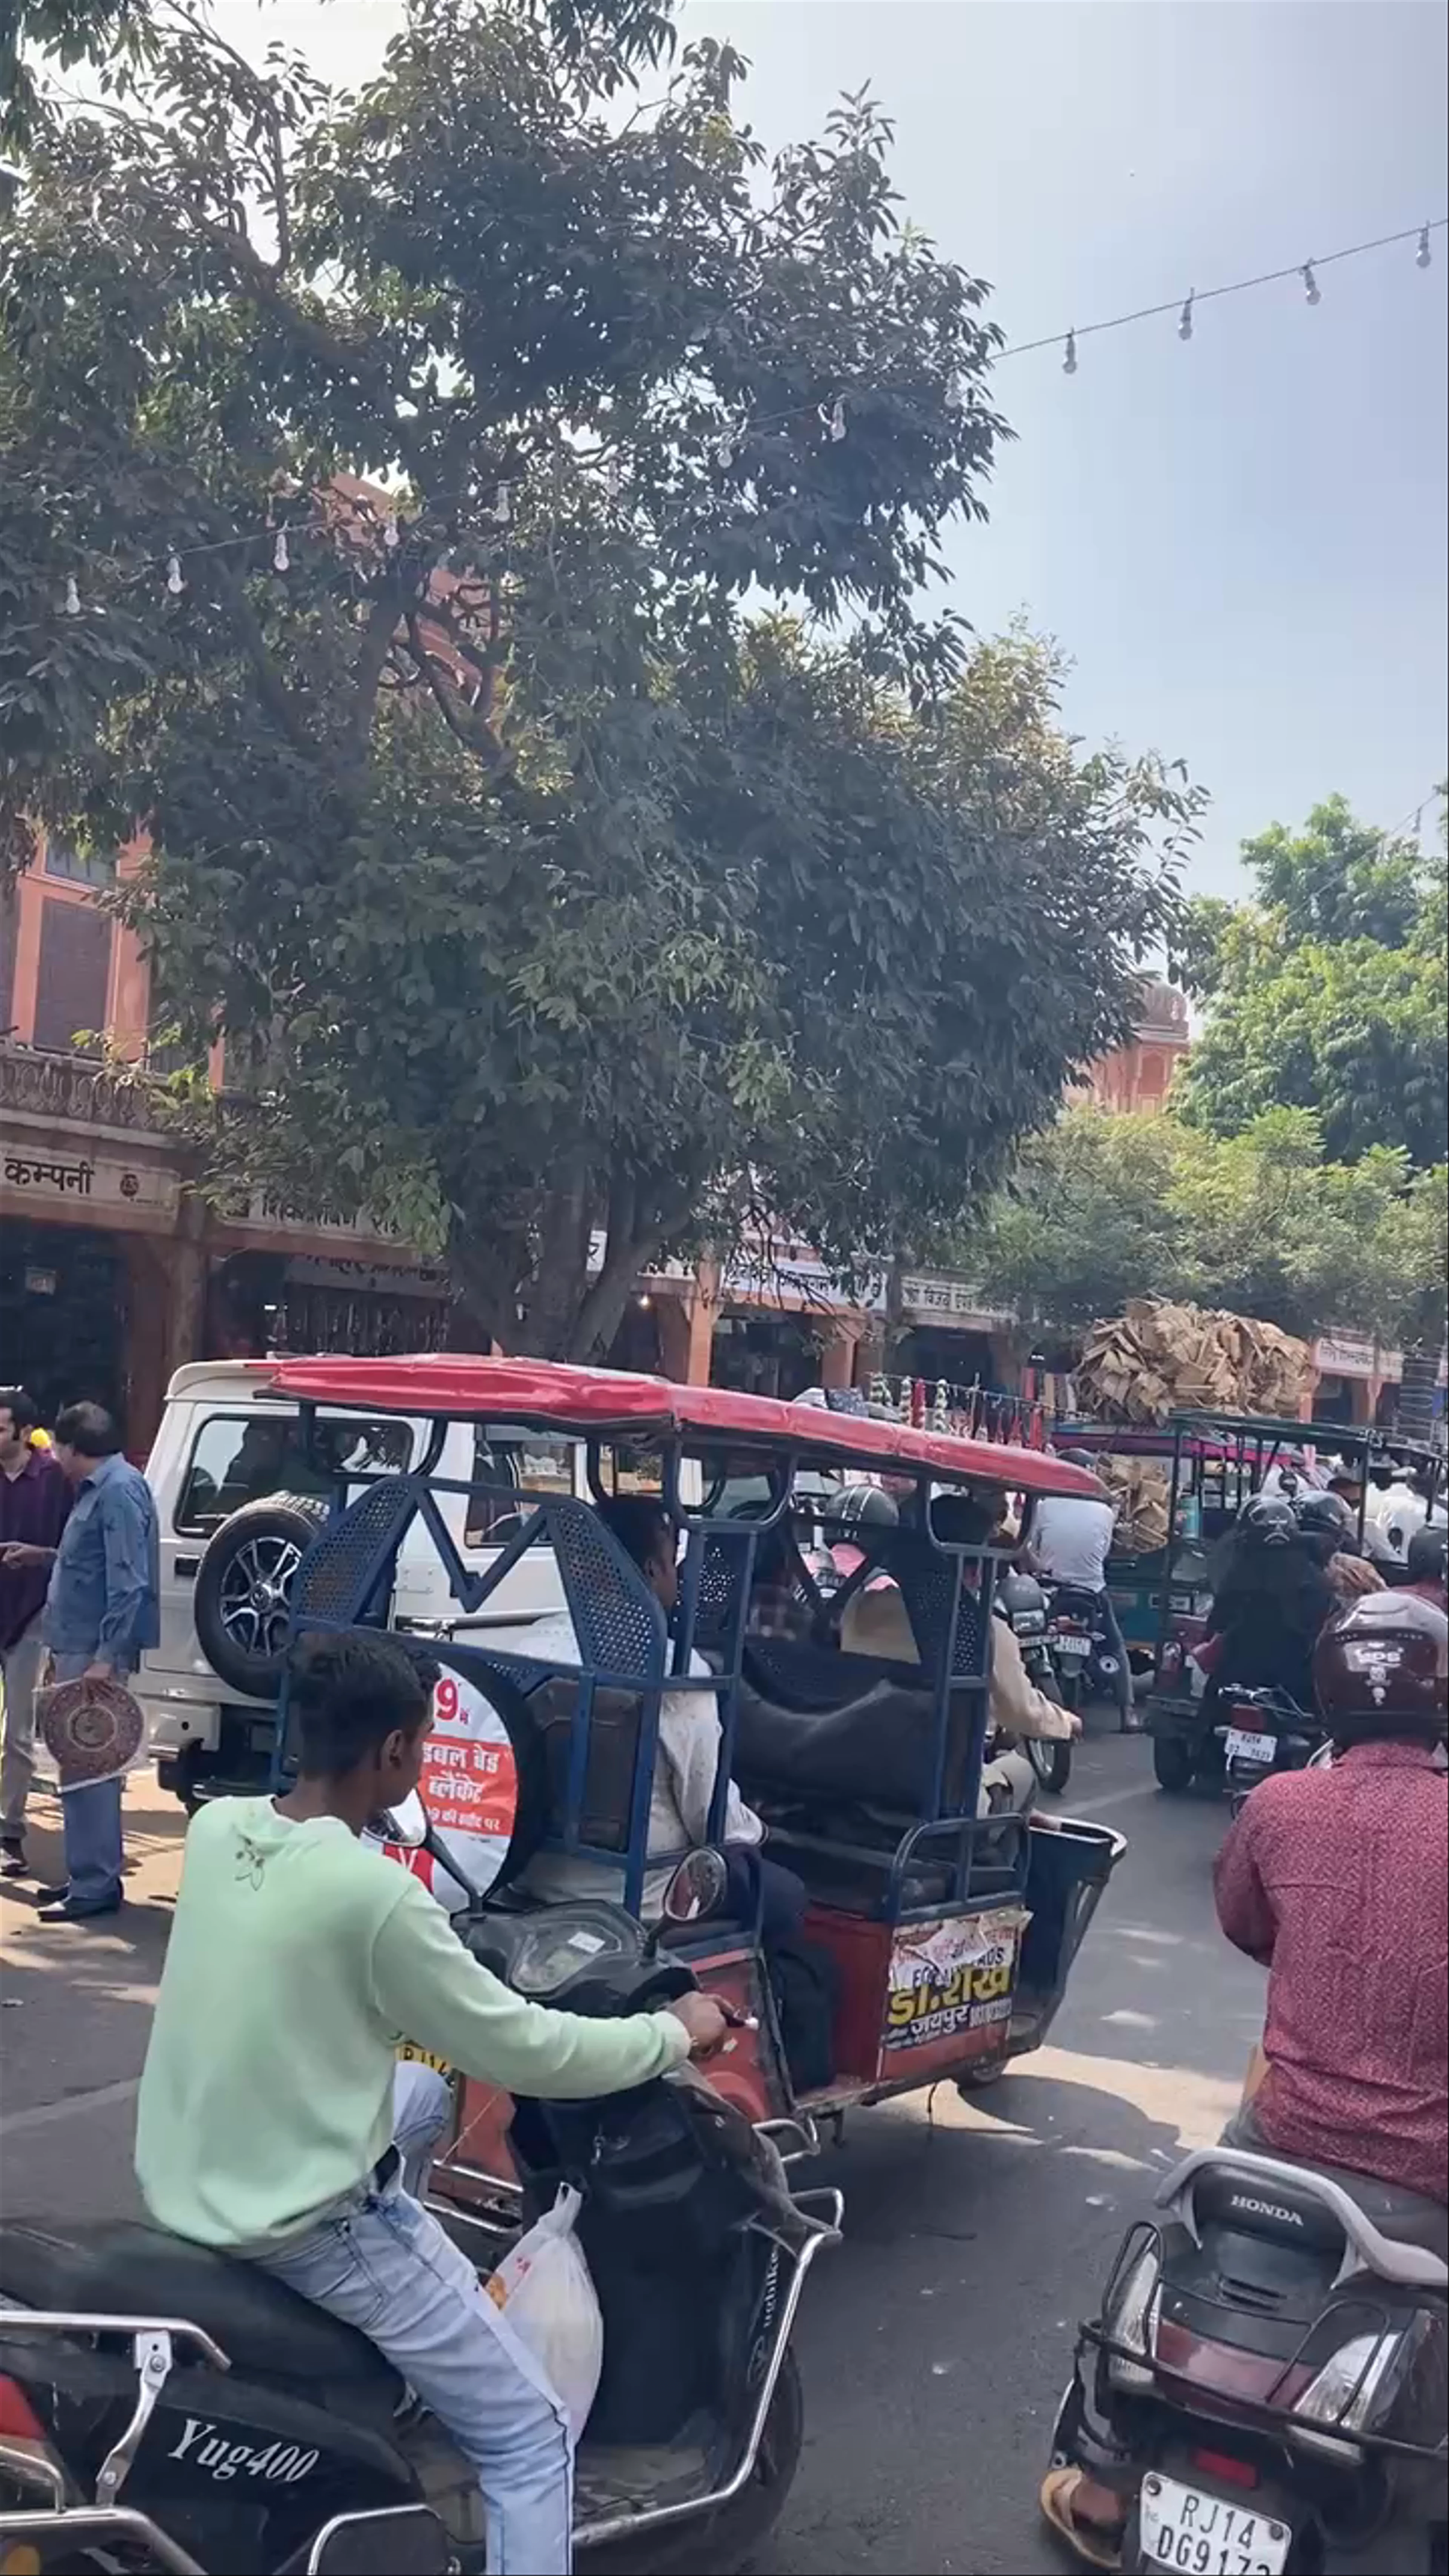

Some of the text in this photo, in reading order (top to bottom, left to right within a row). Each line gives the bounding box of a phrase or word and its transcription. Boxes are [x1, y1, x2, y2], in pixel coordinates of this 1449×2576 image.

[4, 1157, 95, 1194] कम्पनी
[910, 2004, 971, 2034] जयपुर
[1231, 2195, 1303, 2226] HONDA
[168, 2418, 320, 2482] Yug400
[1180, 2494, 1256, 2550] RJ14
